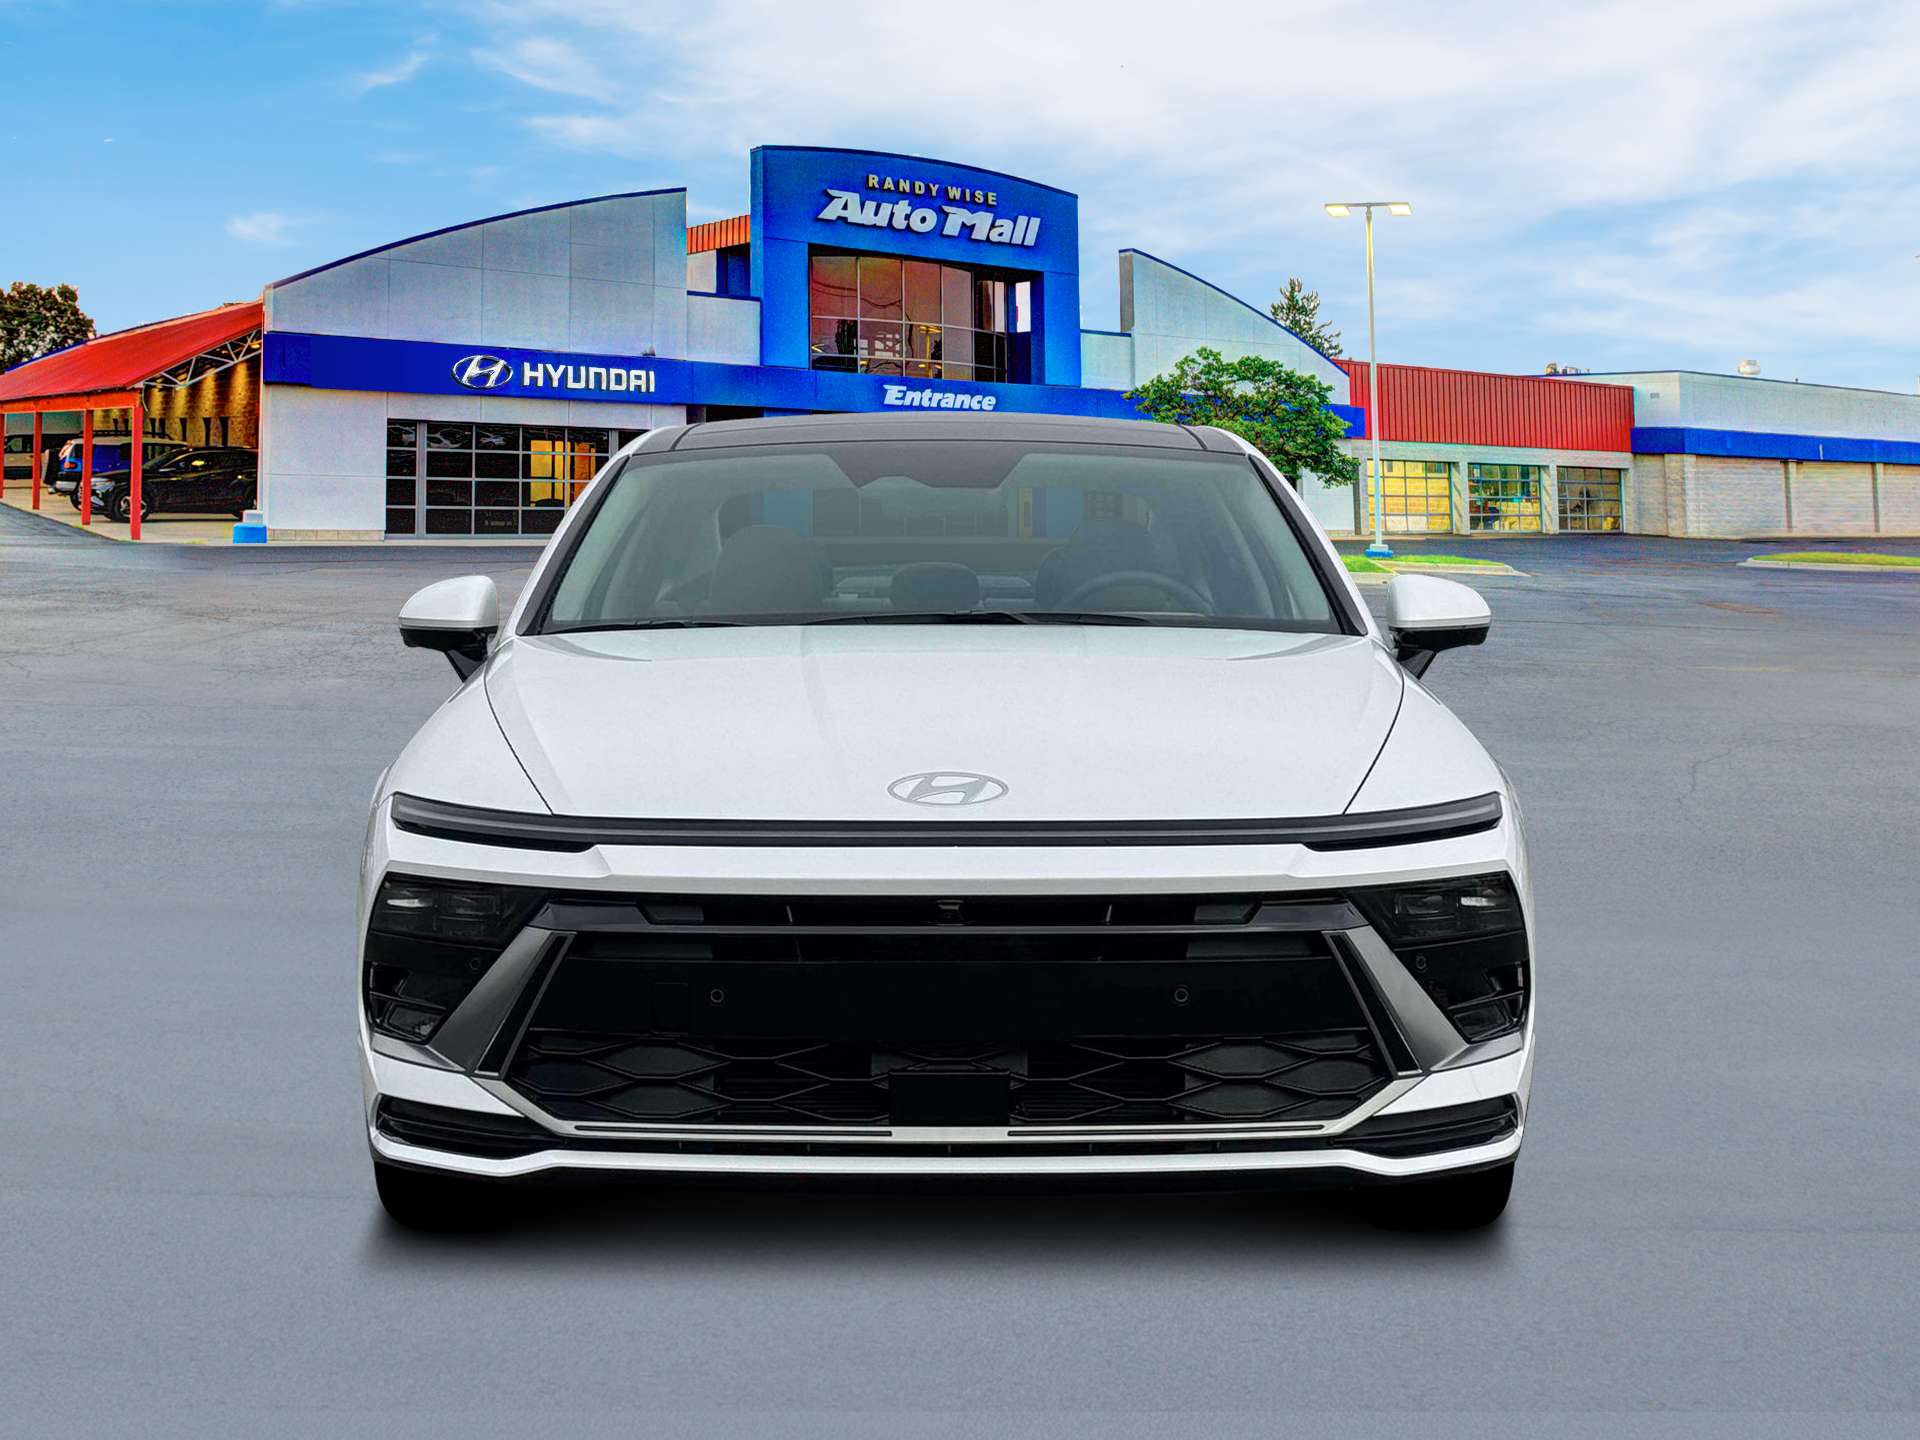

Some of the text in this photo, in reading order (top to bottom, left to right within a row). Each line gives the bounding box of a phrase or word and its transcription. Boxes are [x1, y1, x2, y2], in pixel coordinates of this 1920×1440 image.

[867, 174, 997, 205] RANDY WISE
[816, 188, 1042, 246] Auto Mall
[523, 361, 656, 393] HYUNDAI
[882, 384, 997, 411] Entrance
